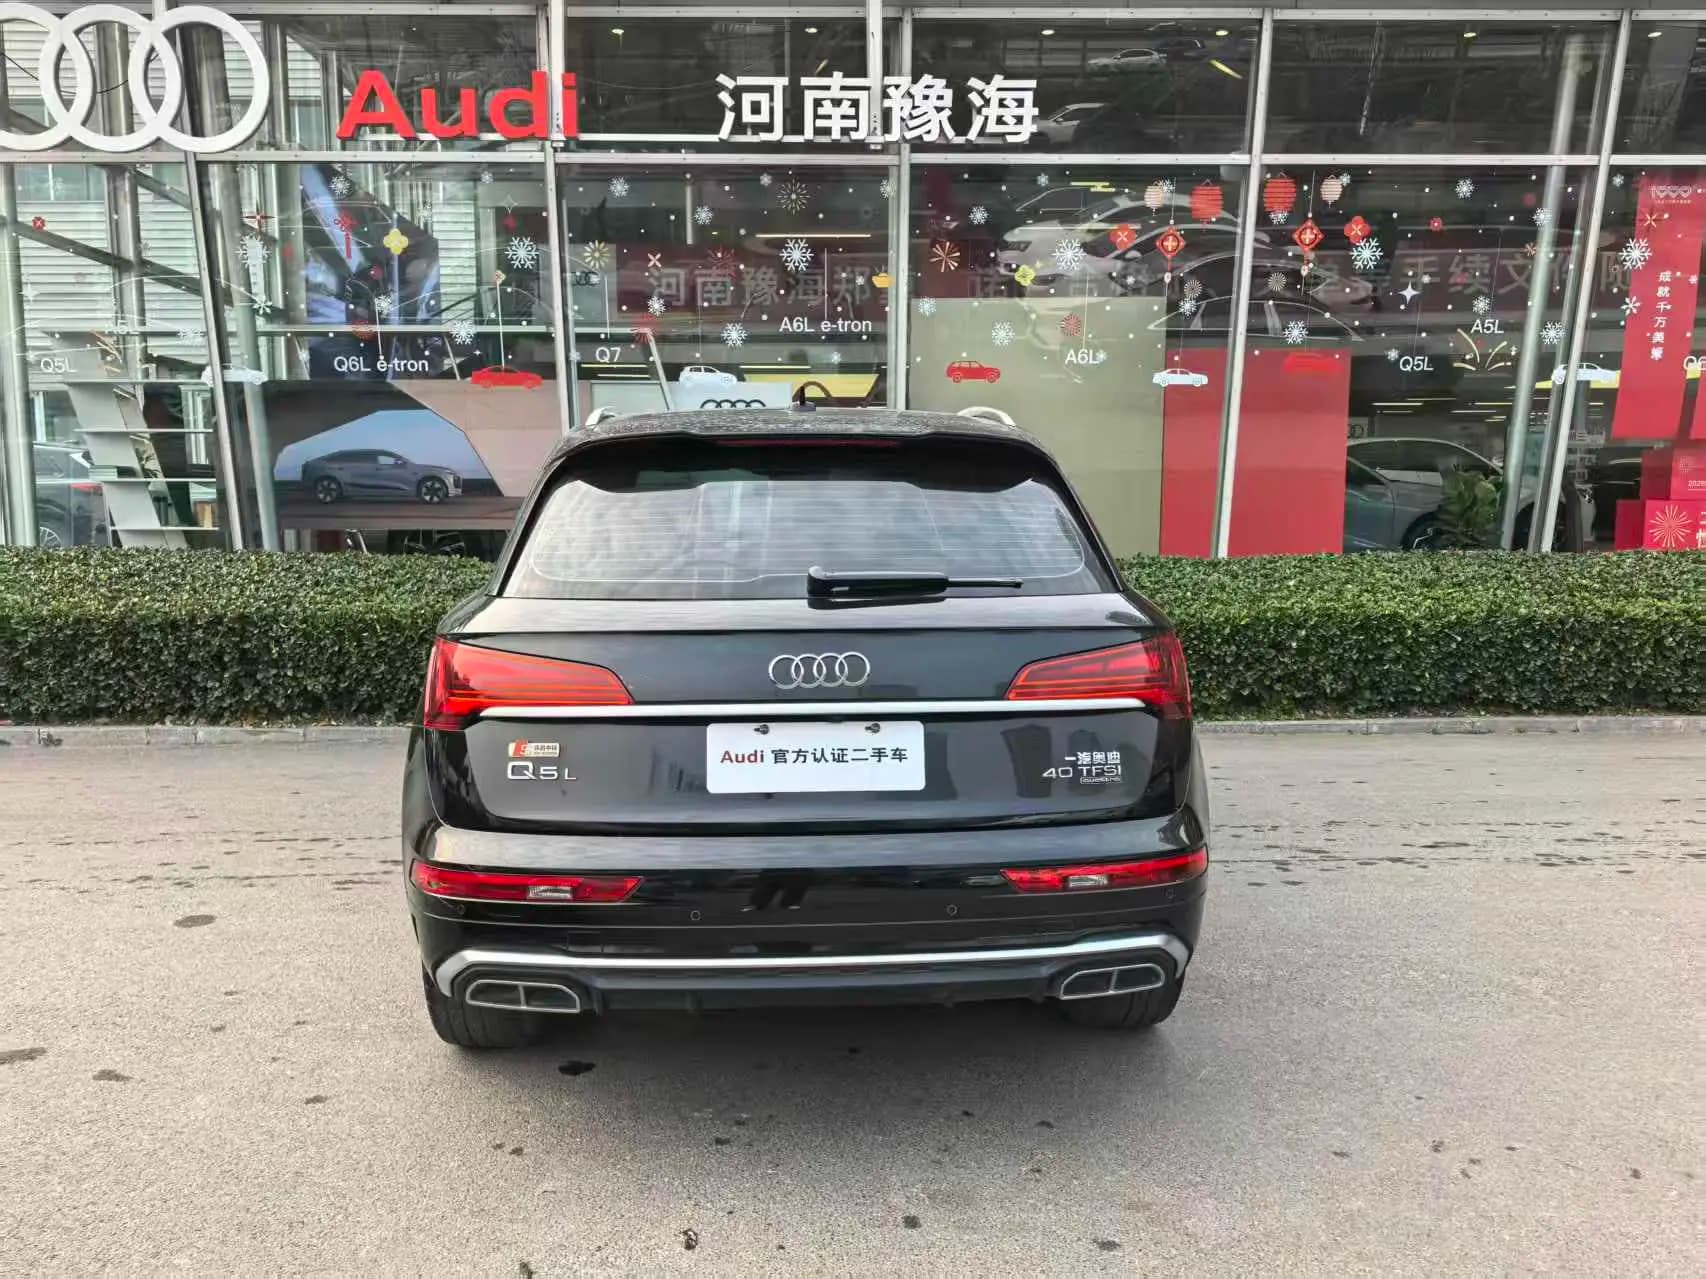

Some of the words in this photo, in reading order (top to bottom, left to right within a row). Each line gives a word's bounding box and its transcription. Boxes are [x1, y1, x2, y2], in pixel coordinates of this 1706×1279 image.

[336, 69, 577, 139] Audi
[715, 71, 1039, 143] 河南豫海
[649, 262, 882, 307] 河南豫海郑
[780, 317, 814, 333] A6L
[821, 317, 873, 333] e-tron
[1470, 319, 1505, 334] A5L
[595, 347, 621, 363] Q7
[1065, 349, 1099, 364] A6L
[40, 357, 77, 373] Q5L
[333, 356, 371, 372] Q6L
[377, 357, 429, 372] e-tron
[1400, 356, 1434, 372] Q5L
[720, 750, 765, 763] Audi
[771, 748, 908, 764] 官方认证二手车
[1064, 750, 1121, 765] 一汽奥迪
[1042, 766, 1073, 779] 40
[1077, 765, 1121, 776] TFSI
